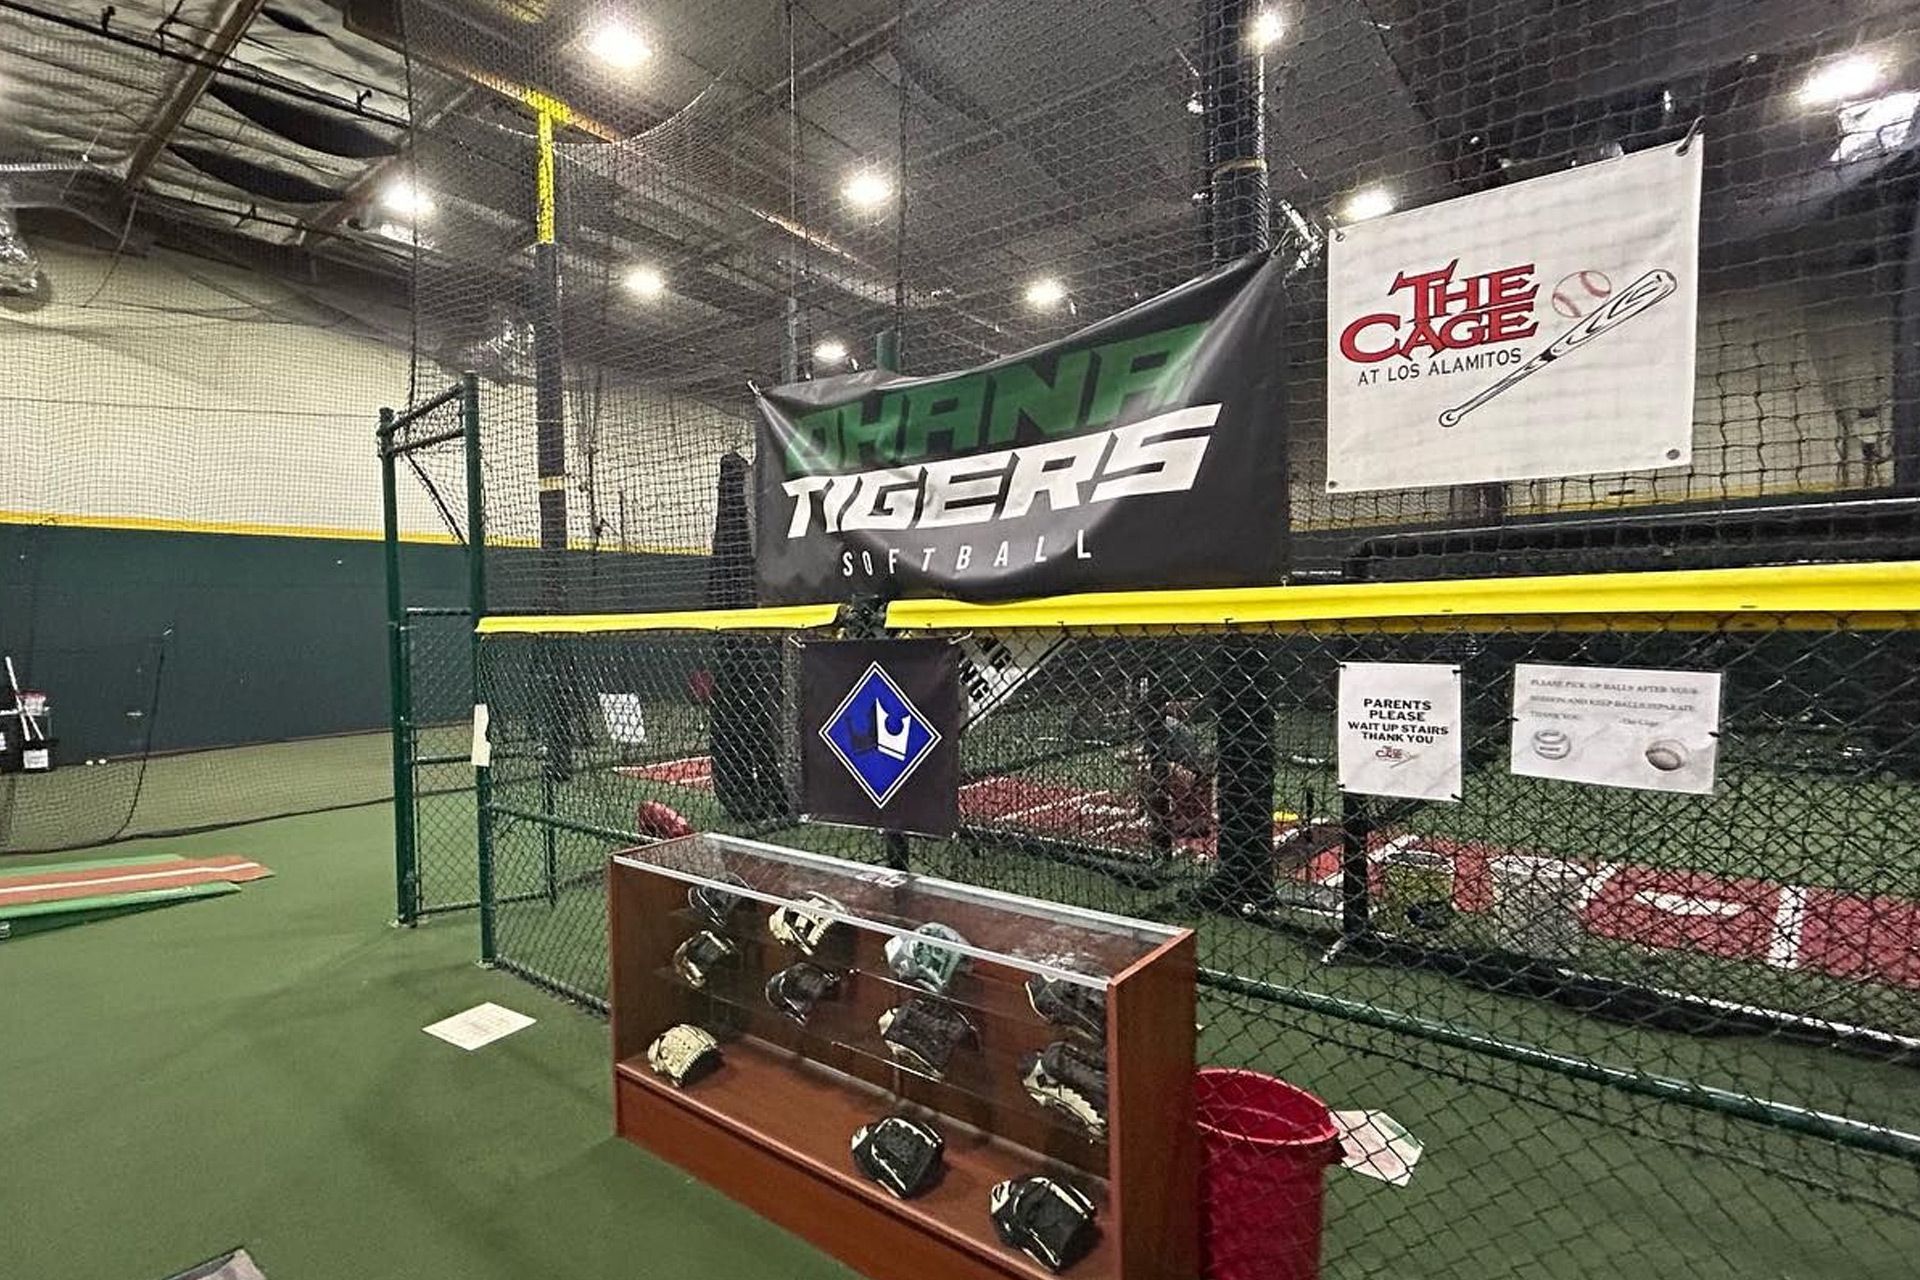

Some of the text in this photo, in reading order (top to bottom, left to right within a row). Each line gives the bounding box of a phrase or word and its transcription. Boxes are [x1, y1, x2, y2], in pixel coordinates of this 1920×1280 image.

[1387, 258, 1540, 324] THE
[1340, 301, 1539, 363] CAGE
[1358, 348, 1521, 386] AT LOS ALAMITOS
[781, 402, 1222, 539] TIGERS
[842, 529, 1093, 578] SOFTBALL
[1363, 698, 1432, 711] PARENTS
[1369, 710, 1426, 722] PLEASE
[1348, 721, 1449, 735] WAIT UP STAIRS
[1361, 731, 1434, 744] THANK YOU
